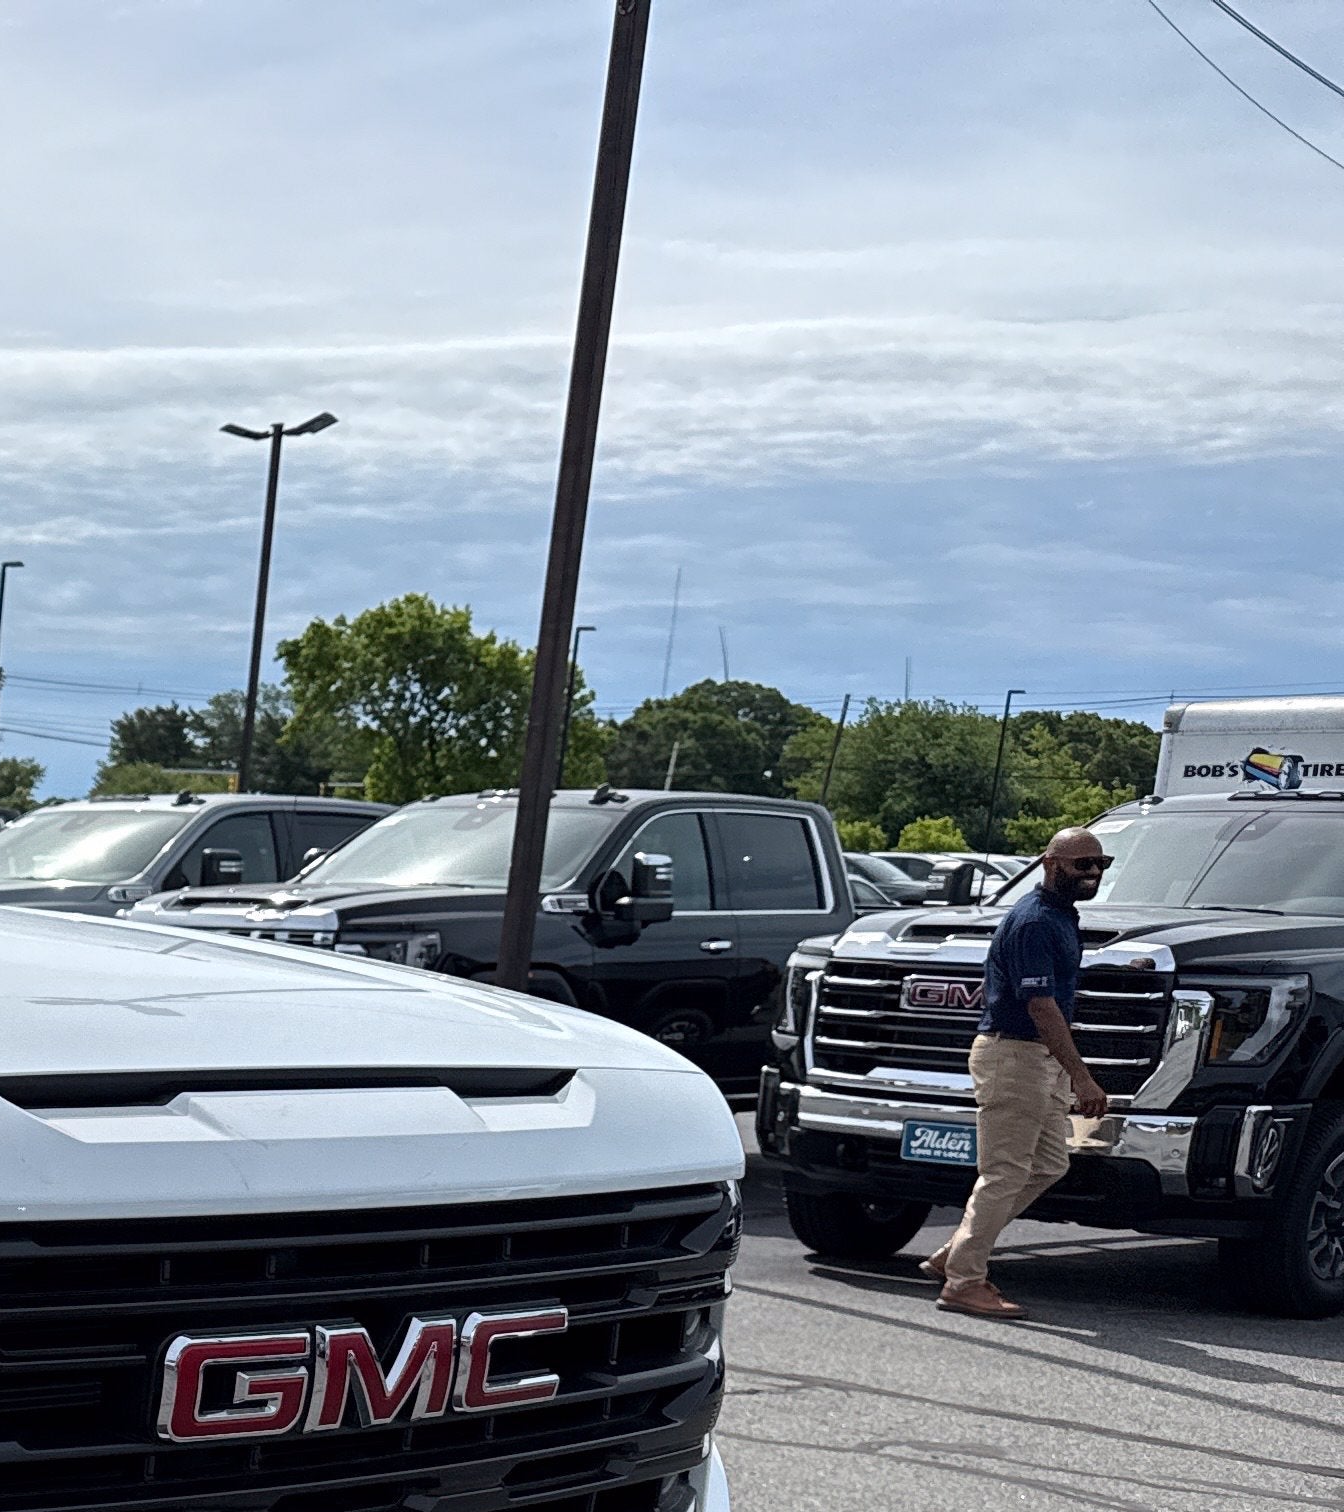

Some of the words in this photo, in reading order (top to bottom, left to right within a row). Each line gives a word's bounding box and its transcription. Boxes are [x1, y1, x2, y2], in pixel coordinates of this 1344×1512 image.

[1184, 762, 1239, 778] BOB'S
[910, 981, 986, 1008] GM
[910, 1126, 972, 1152] Alden
[157, 1306, 569, 1443] GMC
